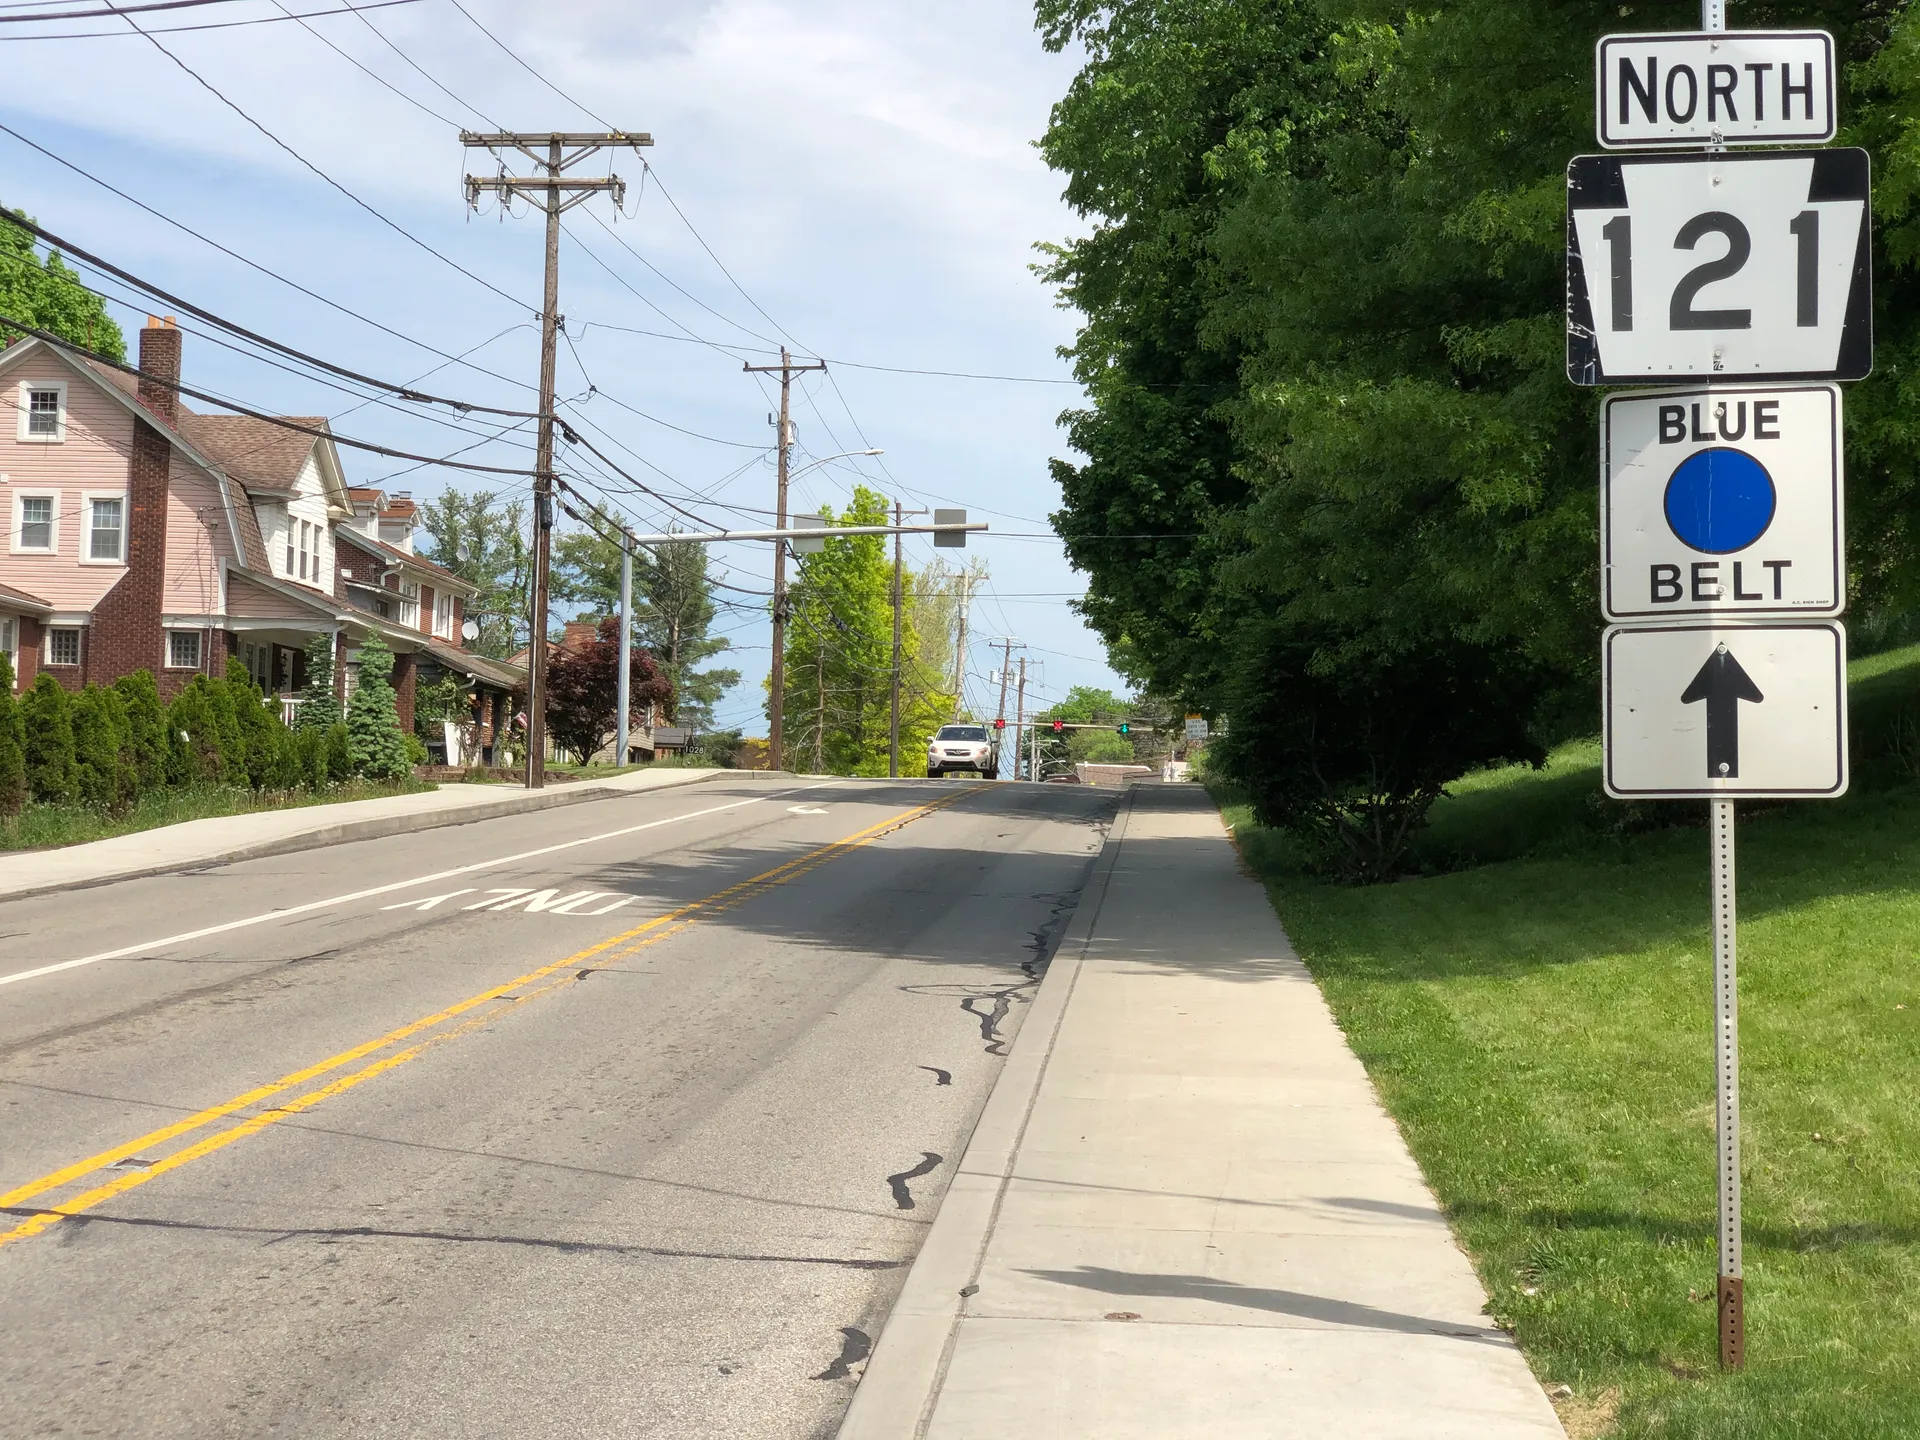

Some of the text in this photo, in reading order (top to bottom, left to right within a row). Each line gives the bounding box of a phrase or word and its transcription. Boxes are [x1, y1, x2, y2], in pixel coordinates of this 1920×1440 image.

[1618, 56, 1814, 125] NORTH
[1603, 211, 1819, 332] 121
[1659, 400, 1780, 444] BLUE
[1650, 560, 1792, 604] BELT
[685, 745, 704, 754] 1028
[379, 888, 644, 916] ONLY
